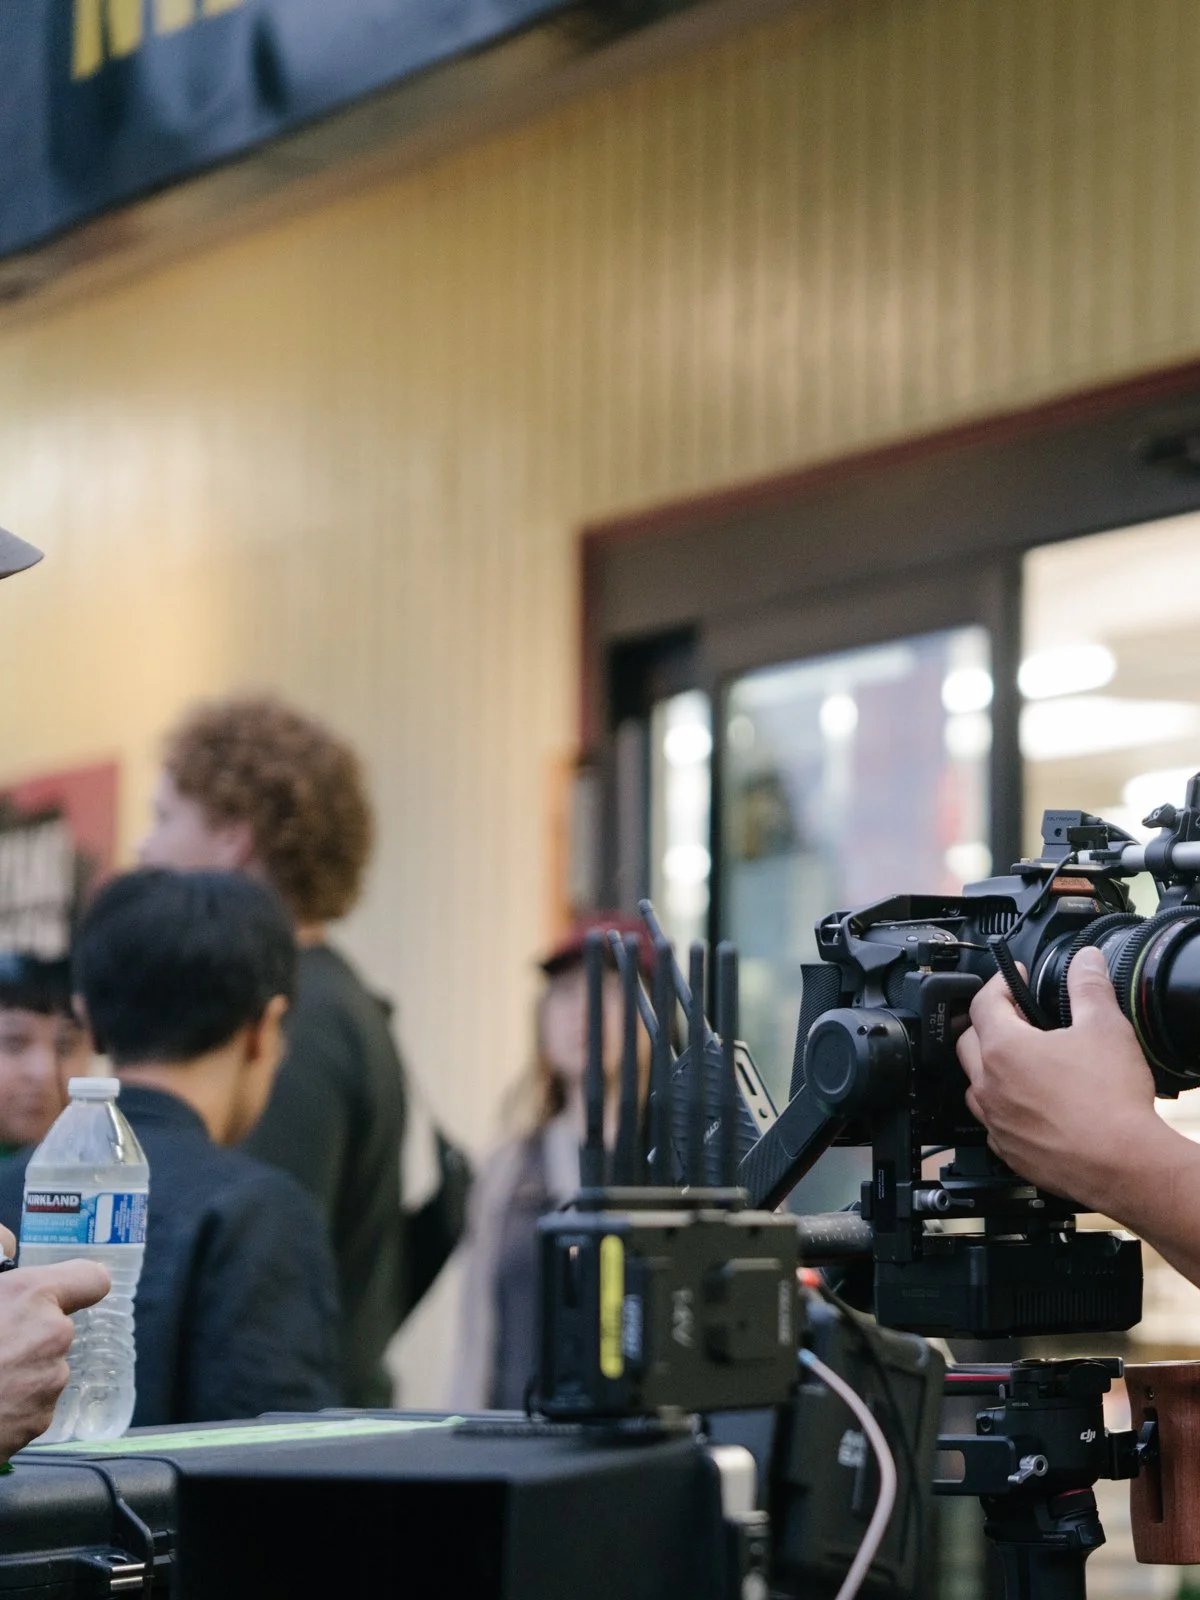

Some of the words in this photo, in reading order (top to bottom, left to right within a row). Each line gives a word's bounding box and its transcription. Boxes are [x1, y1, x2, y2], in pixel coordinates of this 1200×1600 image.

[936, 1002, 946, 1043] DEITY
[27, 1194, 80, 1207] KIRKLAND
[1080, 1428, 1096, 1443] dji
